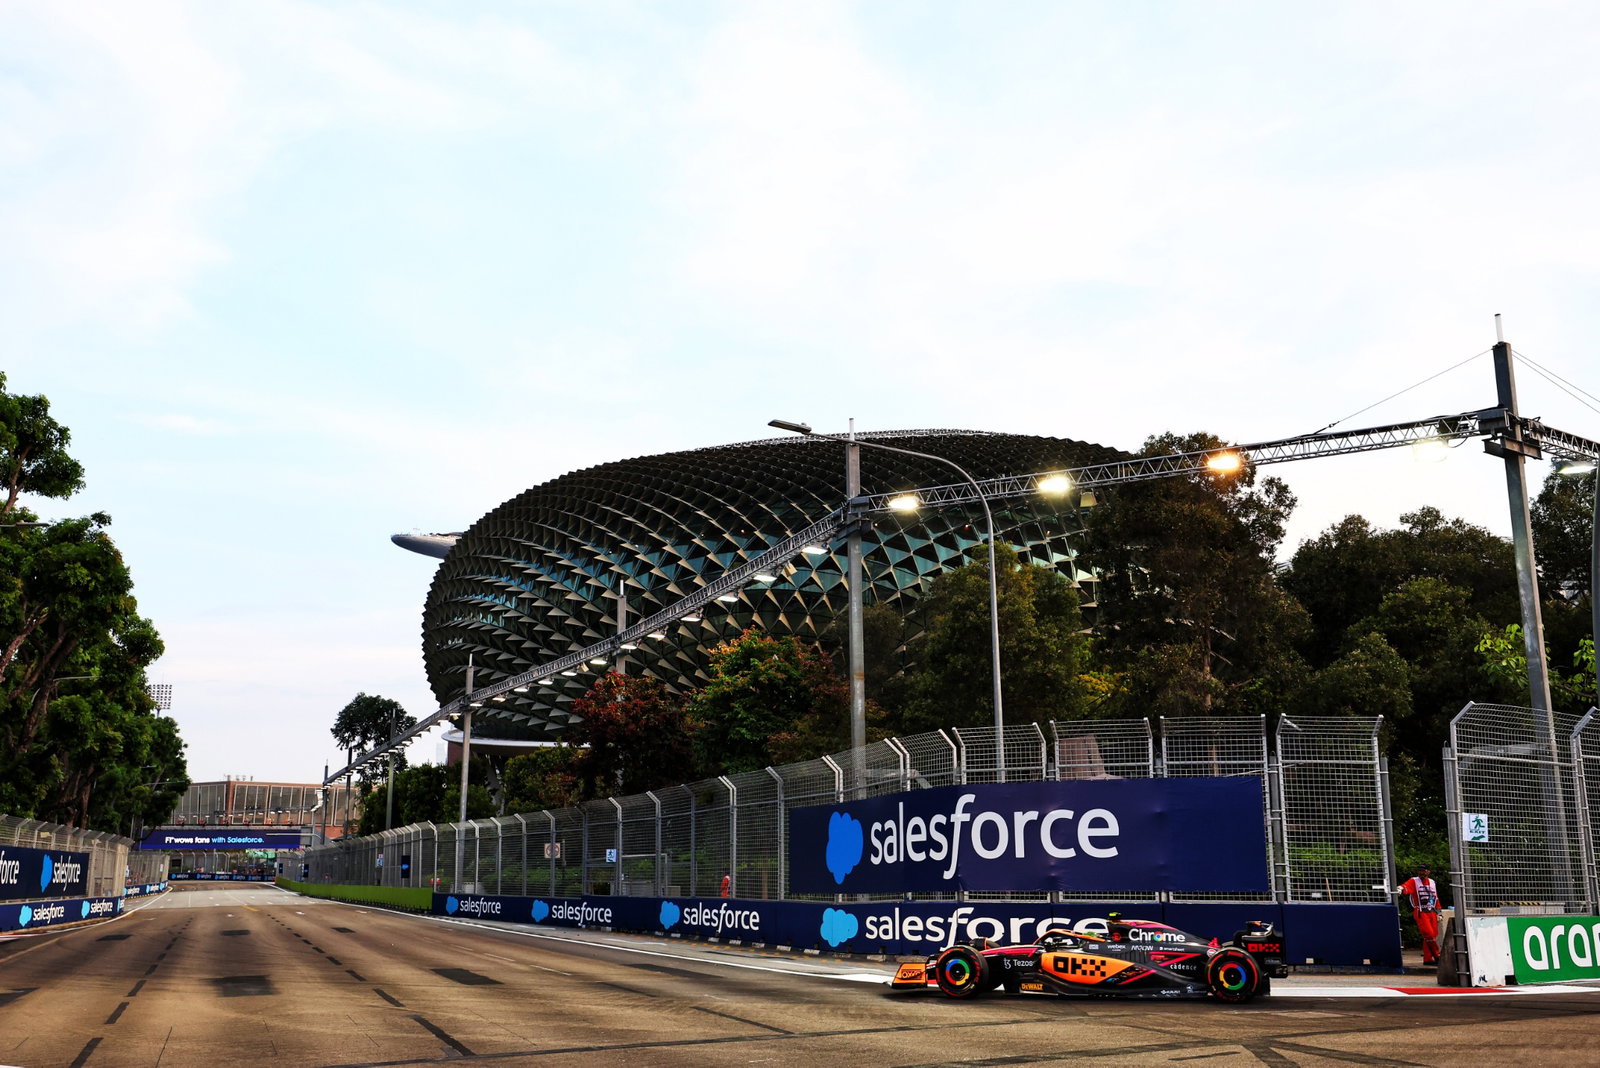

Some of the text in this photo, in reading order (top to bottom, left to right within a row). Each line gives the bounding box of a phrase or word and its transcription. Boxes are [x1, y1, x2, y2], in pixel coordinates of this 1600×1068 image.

[870, 794, 1120, 880] salesforce
[53, 854, 81, 891] salesforce
[33, 902, 65, 924] salesforce
[90, 899, 113, 917] salesforce
[459, 898, 501, 917] salesforce
[551, 901, 612, 926] salesforce
[683, 902, 760, 935] salesforce
[1128, 928, 1186, 943] Chrome
[1247, 943, 1281, 953] OKX
[1012, 959, 1034, 967] Tezos
[1053, 955, 1107, 977] OKX
